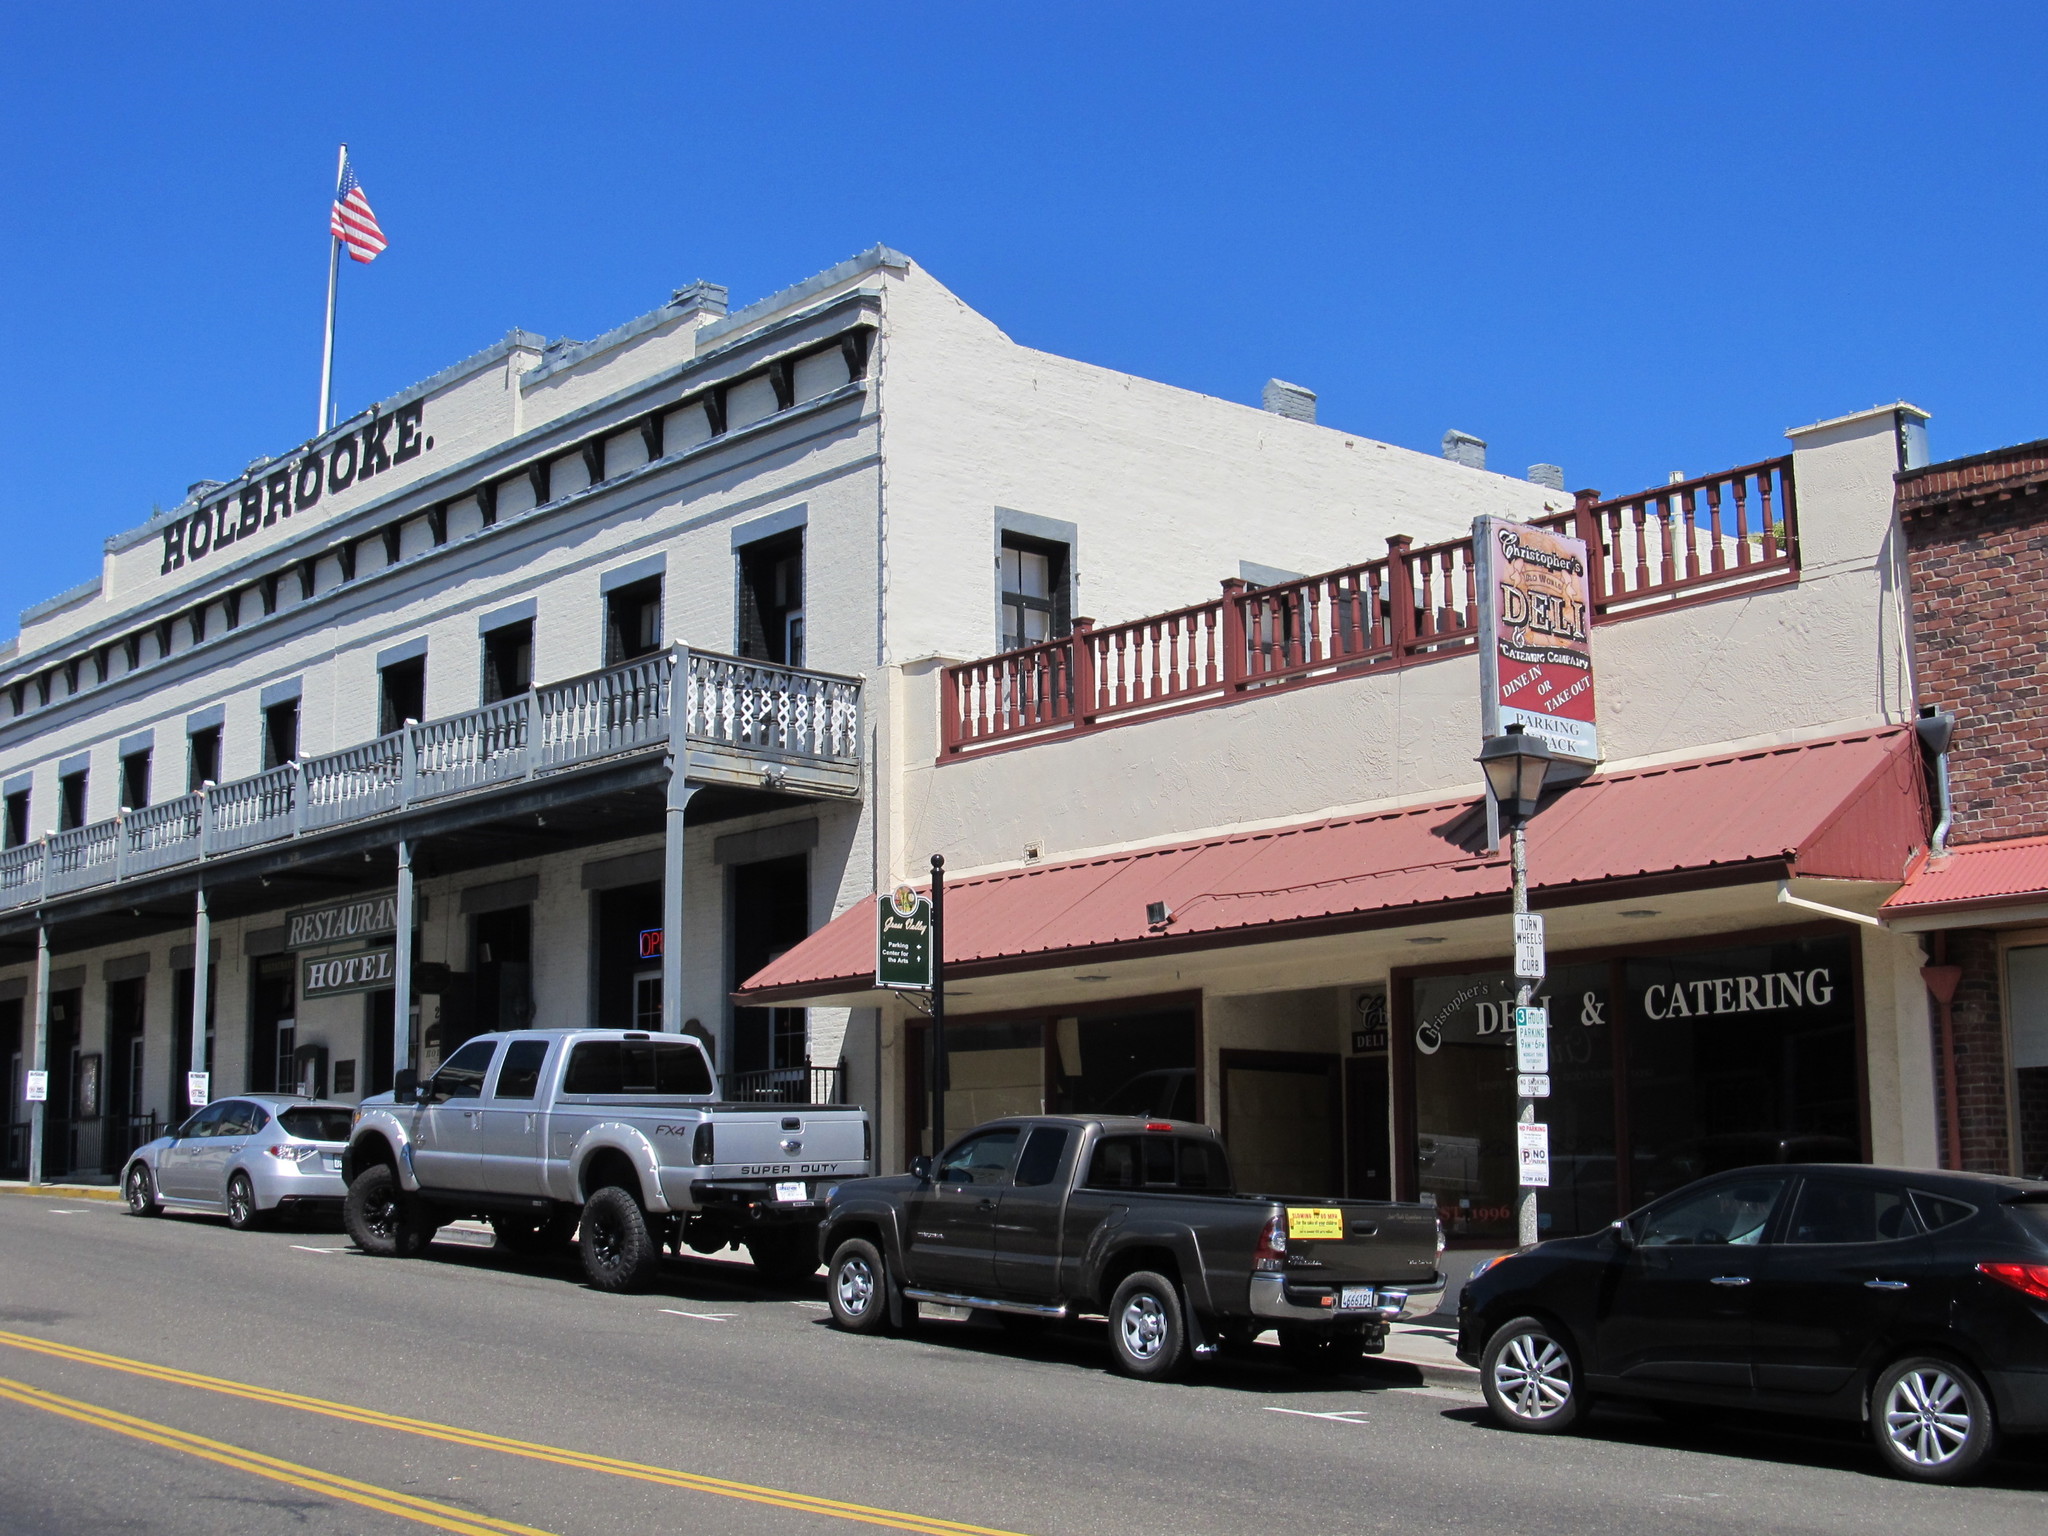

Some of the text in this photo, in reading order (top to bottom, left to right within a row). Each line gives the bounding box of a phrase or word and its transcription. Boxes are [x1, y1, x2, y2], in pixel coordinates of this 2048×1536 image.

[161, 398, 435, 576] HOLBROOKE.
[1499, 528, 1582, 575] Christopher's
[1500, 583, 1586, 640] DELI
[1512, 626, 1525, 648] &
[1547, 651, 1589, 670] COMPANY
[1502, 664, 1543, 698] DINE IN
[1537, 679, 1553, 696] OR
[1544, 675, 1591, 713] TAKE OUT
[1516, 712, 1580, 736] PARKING
[288, 898, 398, 946] RESTAURAN
[884, 916, 927, 936] Grass Valley
[1520, 918, 1538, 931] TURN
[888, 941, 909, 950] Parking
[1516, 932, 1543, 945] WHEELS
[882, 949, 900, 957] Center
[1526, 945, 1535, 958] TO
[307, 952, 393, 990] HOTEL
[1521, 959, 1540, 972] CURB
[1475, 968, 1834, 1036] DEI & CATERING
[1415, 980, 1489, 1055] Christopher's
[1518, 1009, 1544, 1025] 3 HOUR
[1357, 1033, 1385, 1048] DELI
[1520, 1027, 1545, 1039] PARKING
[655, 1124, 686, 1137] FX4
[1533, 1149, 1546, 1159] NO
[741, 1164, 839, 1175] SUPER DUTY
[1471, 1204, 1511, 1222] 1996
